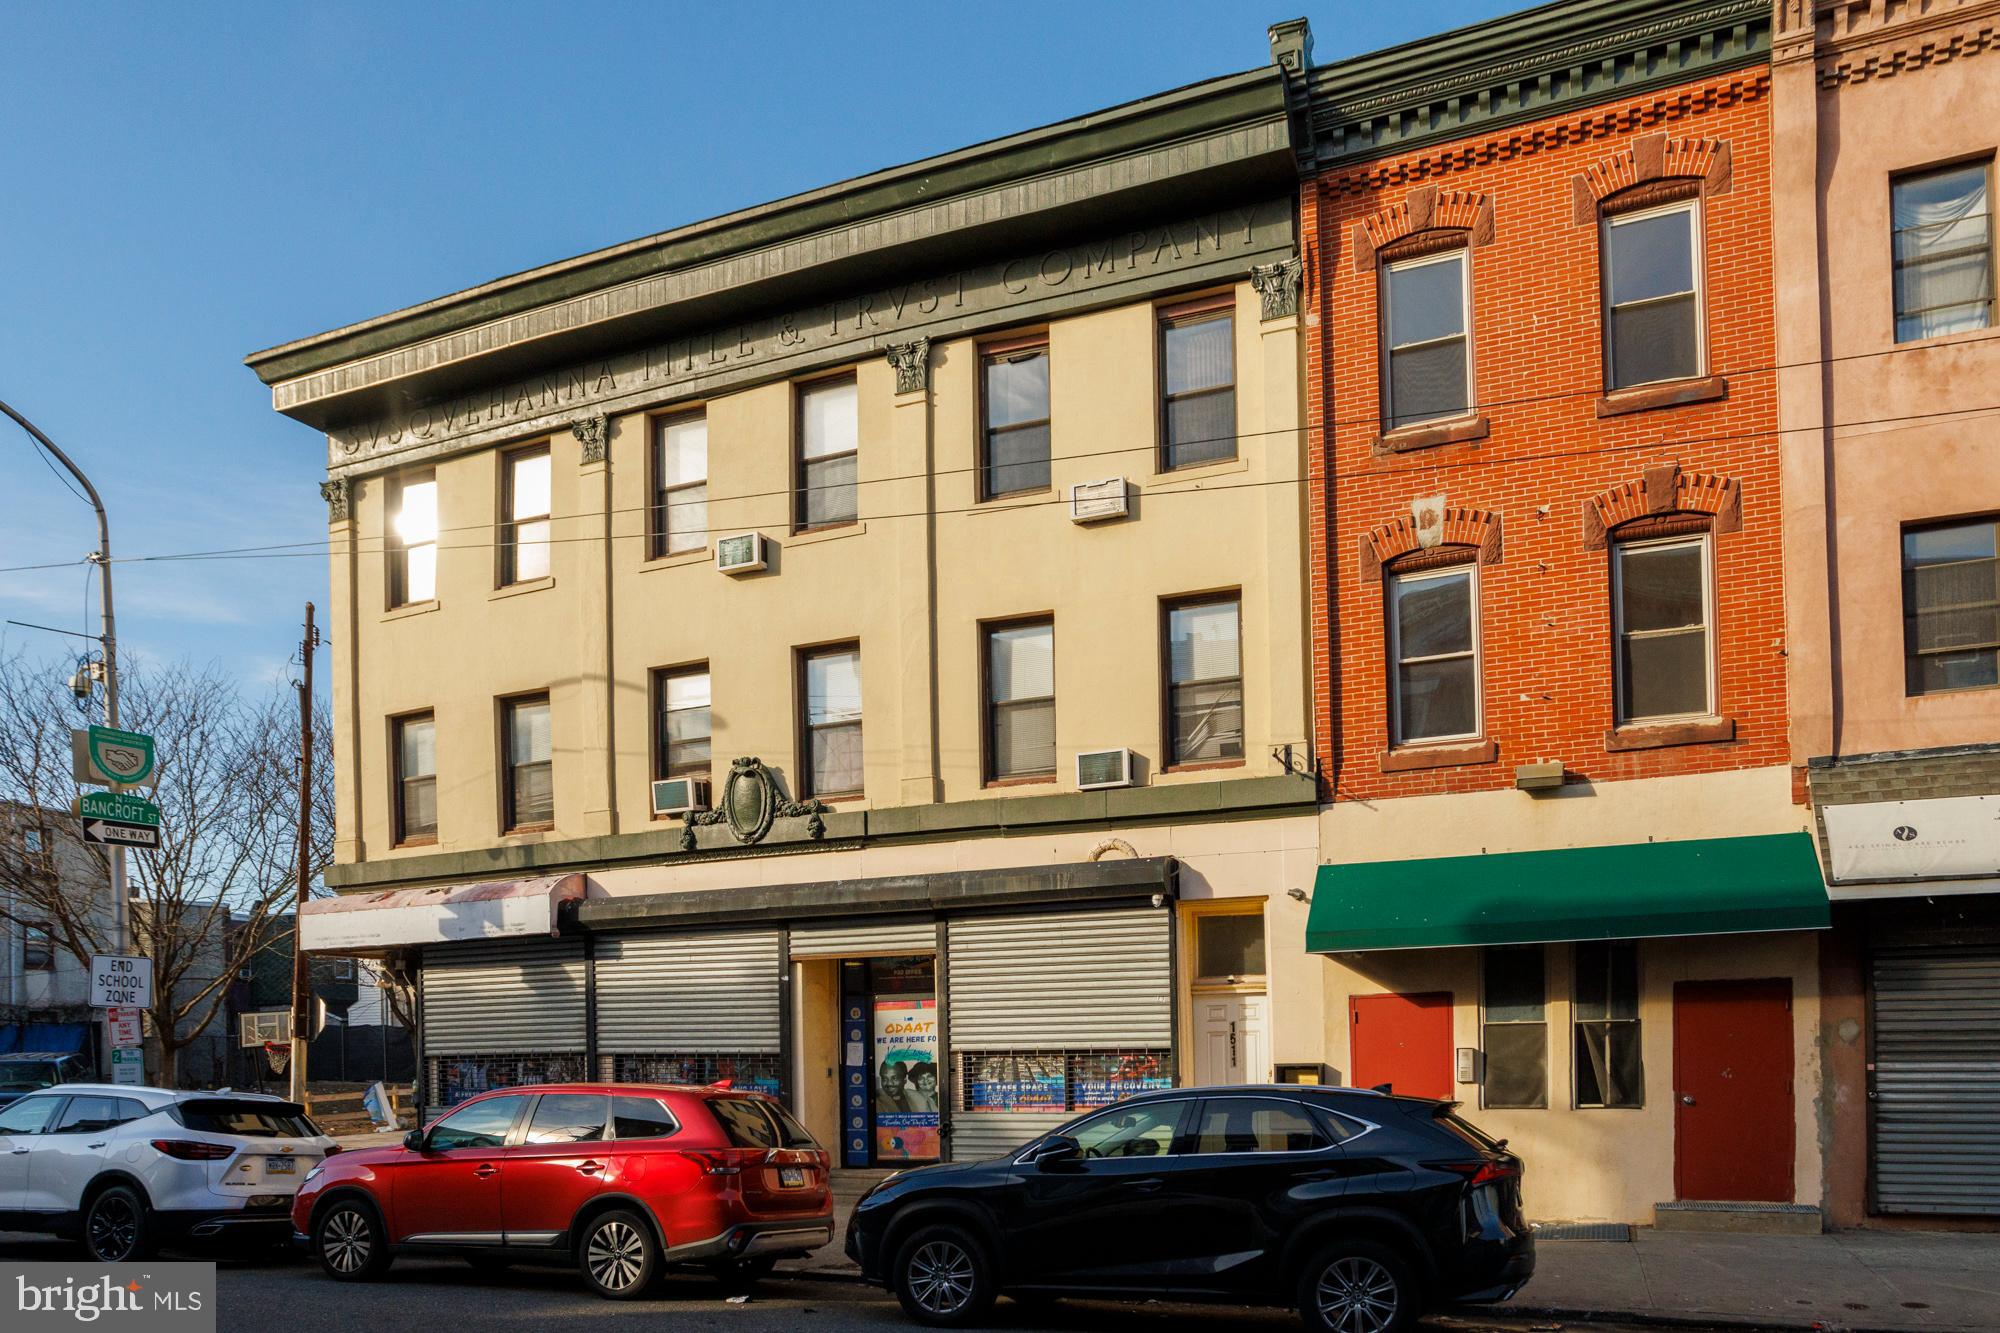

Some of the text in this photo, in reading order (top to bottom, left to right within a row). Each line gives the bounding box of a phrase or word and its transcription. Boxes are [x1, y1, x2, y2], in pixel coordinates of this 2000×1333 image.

[638, 326, 755, 382] TITLE
[777, 313, 806, 347] &
[1002, 206, 1259, 294] COMPANY
[115, 795, 123, 803] N
[82, 798, 157, 824] BANCROFT ST
[105, 827, 151, 841] ONE WAY
[111, 960, 134, 973] END
[98, 974, 144, 989] SCHOOL
[105, 990, 136, 1004] ZONE
[884, 1021, 935, 1034] ODAAT
[889, 1036, 904, 1044] ARE
[906, 1035, 925, 1043] HERE
[113, 1052, 120, 1062] 2
[996, 1084, 1018, 1092] SAFE
[1020, 1083, 1049, 1092] SPACE
[1081, 1080, 1161, 1091] YOUR RECOVERY
